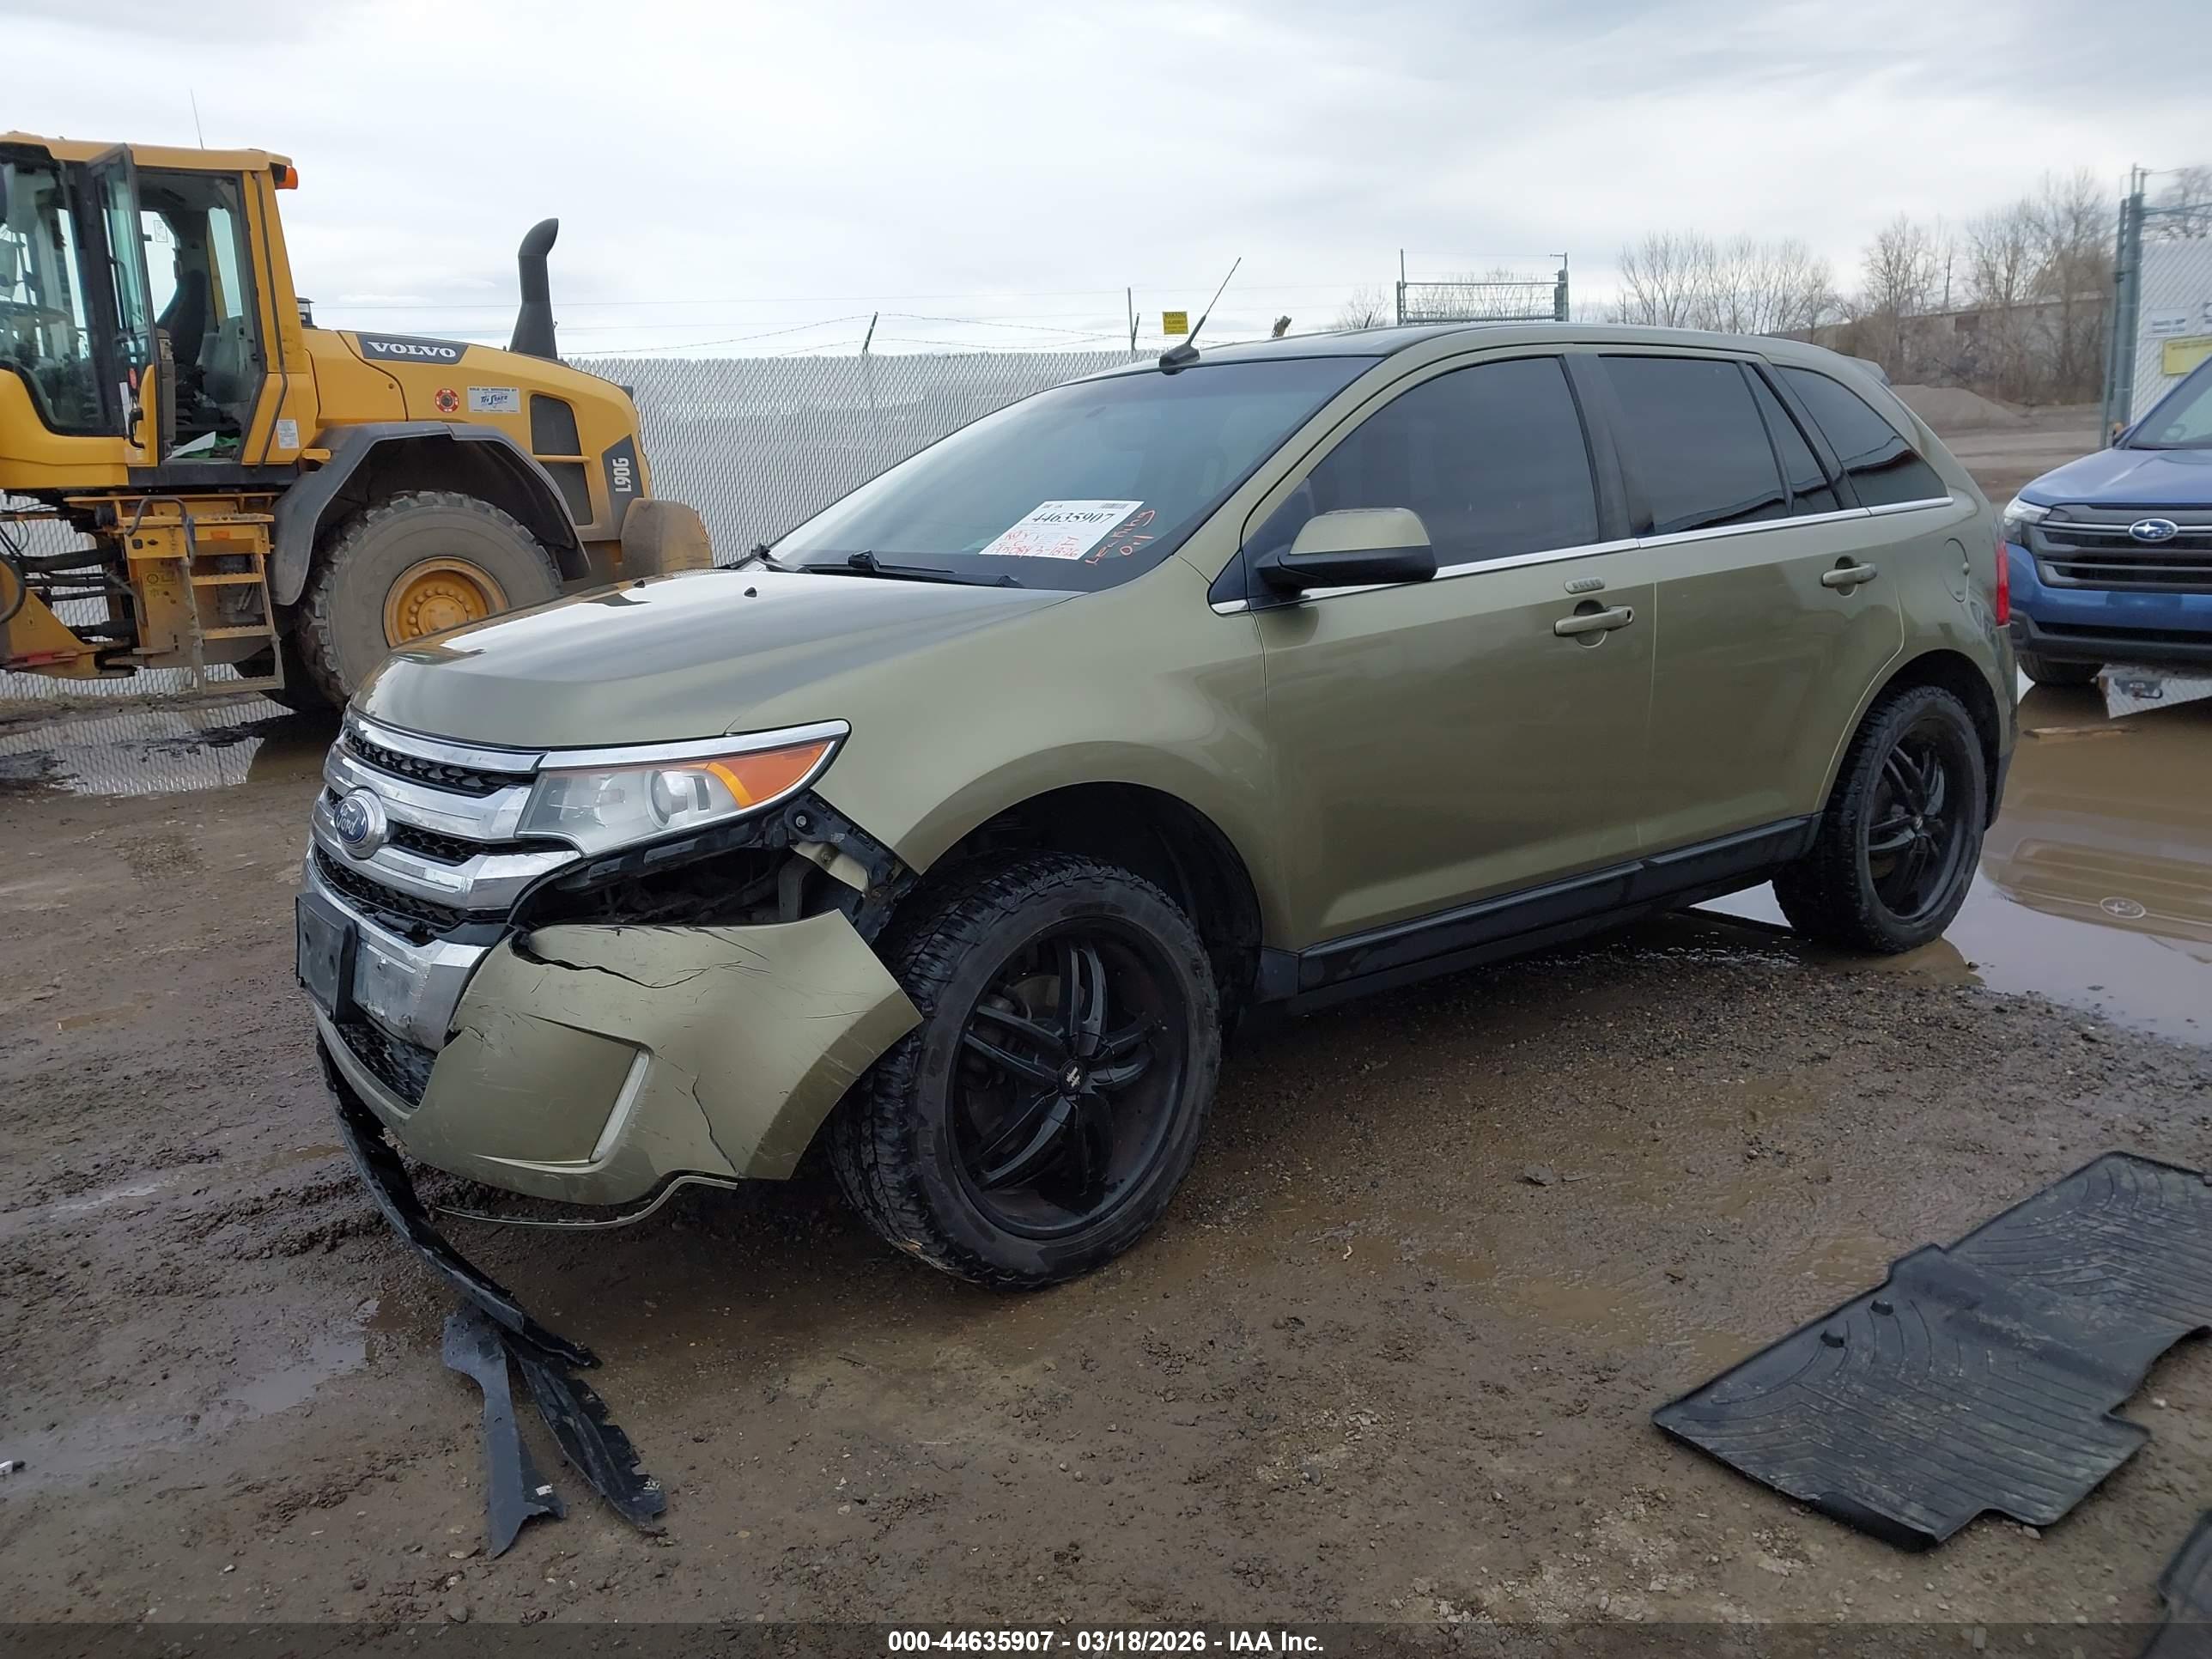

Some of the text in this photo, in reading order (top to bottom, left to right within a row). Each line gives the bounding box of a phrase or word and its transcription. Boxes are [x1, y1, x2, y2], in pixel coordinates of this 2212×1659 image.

[367, 341, 456, 358] VOLVO
[611, 457, 632, 492] L90G
[1032, 512, 1115, 524] 44635907
[336, 803, 359, 837] Ford
